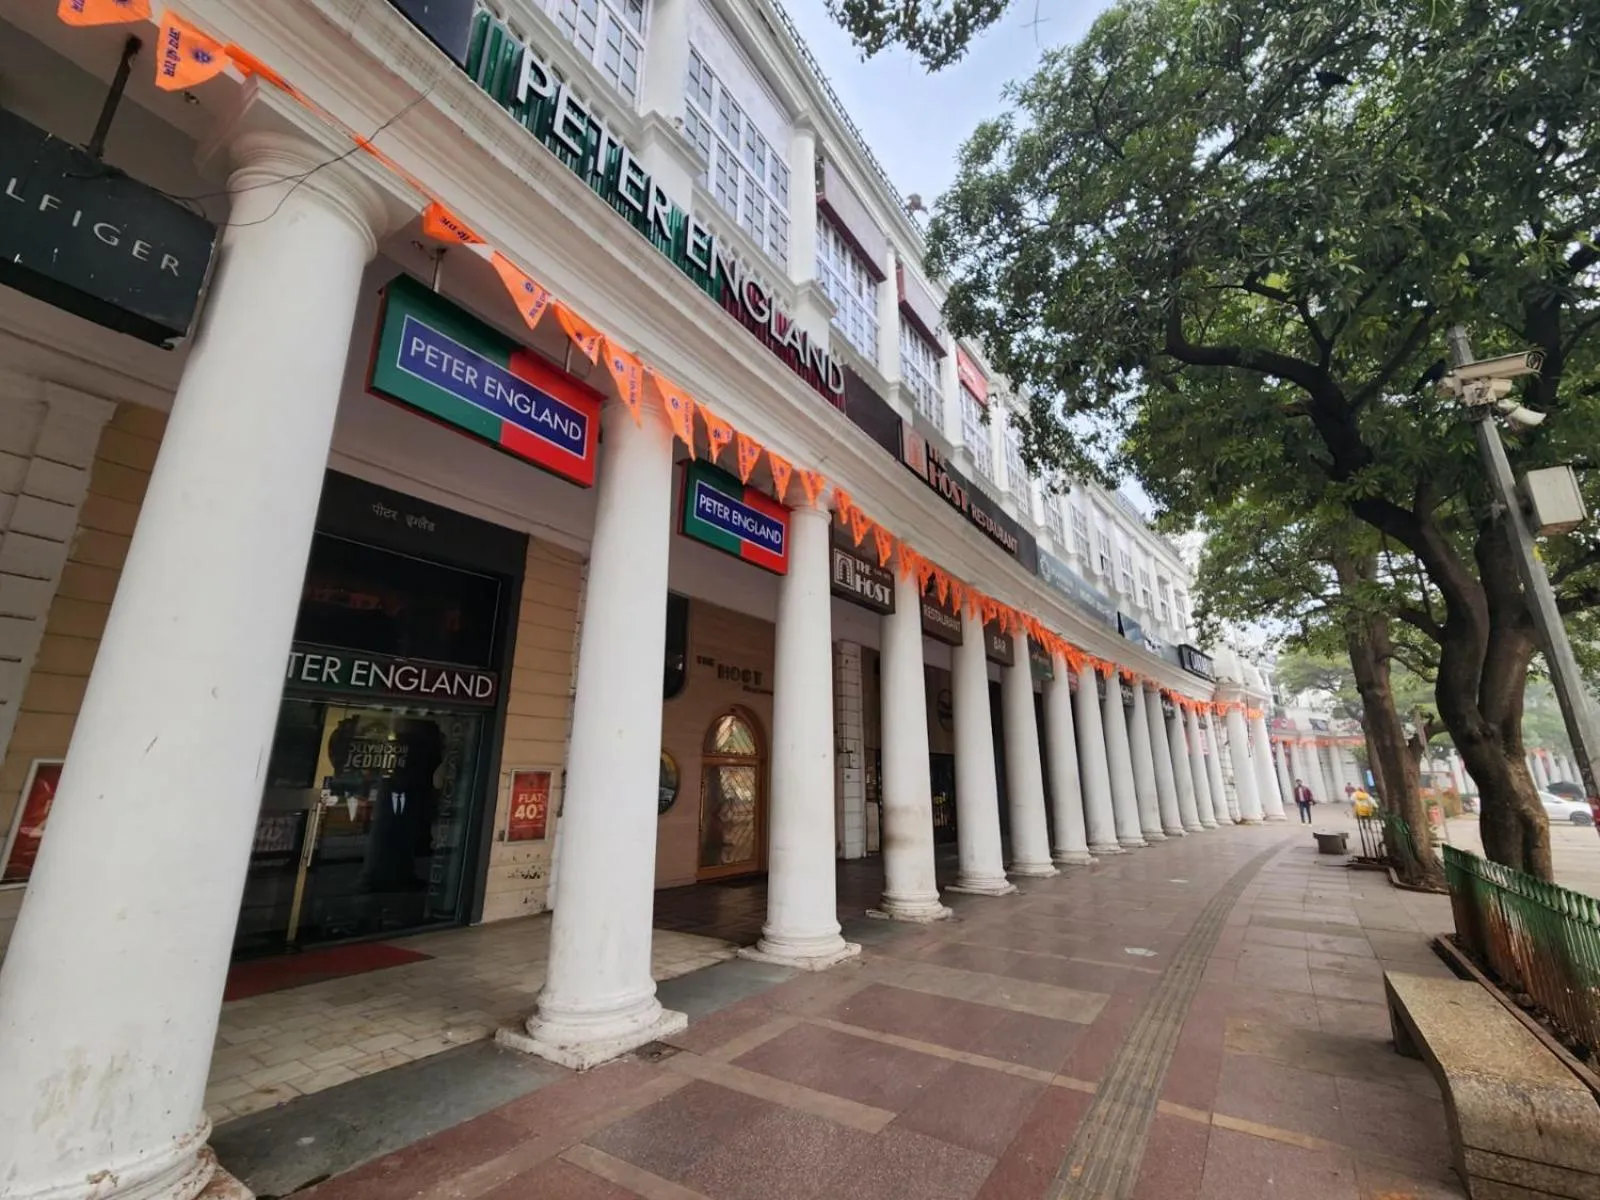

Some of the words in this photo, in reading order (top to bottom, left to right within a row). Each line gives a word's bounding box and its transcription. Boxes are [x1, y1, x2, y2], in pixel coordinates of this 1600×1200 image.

[516, 48, 674, 241] PETER
[686, 212, 846, 395] ENGLAND
[410, 336, 478, 389] PETER
[483, 375, 582, 441] ENGLAND
[699, 494, 730, 522] PETER
[731, 510, 782, 544] ENGLAND
[929, 461, 968, 513] HOST
[970, 502, 1018, 554] RESTAURANT
[855, 558, 873, 576] THE
[855, 573, 892, 606] HOST
[923, 604, 961, 632] RESTAURANT
[350, 660, 493, 698] ENGLAND
[717, 663, 764, 686] HOST
[518, 793, 543, 804] FLAT
